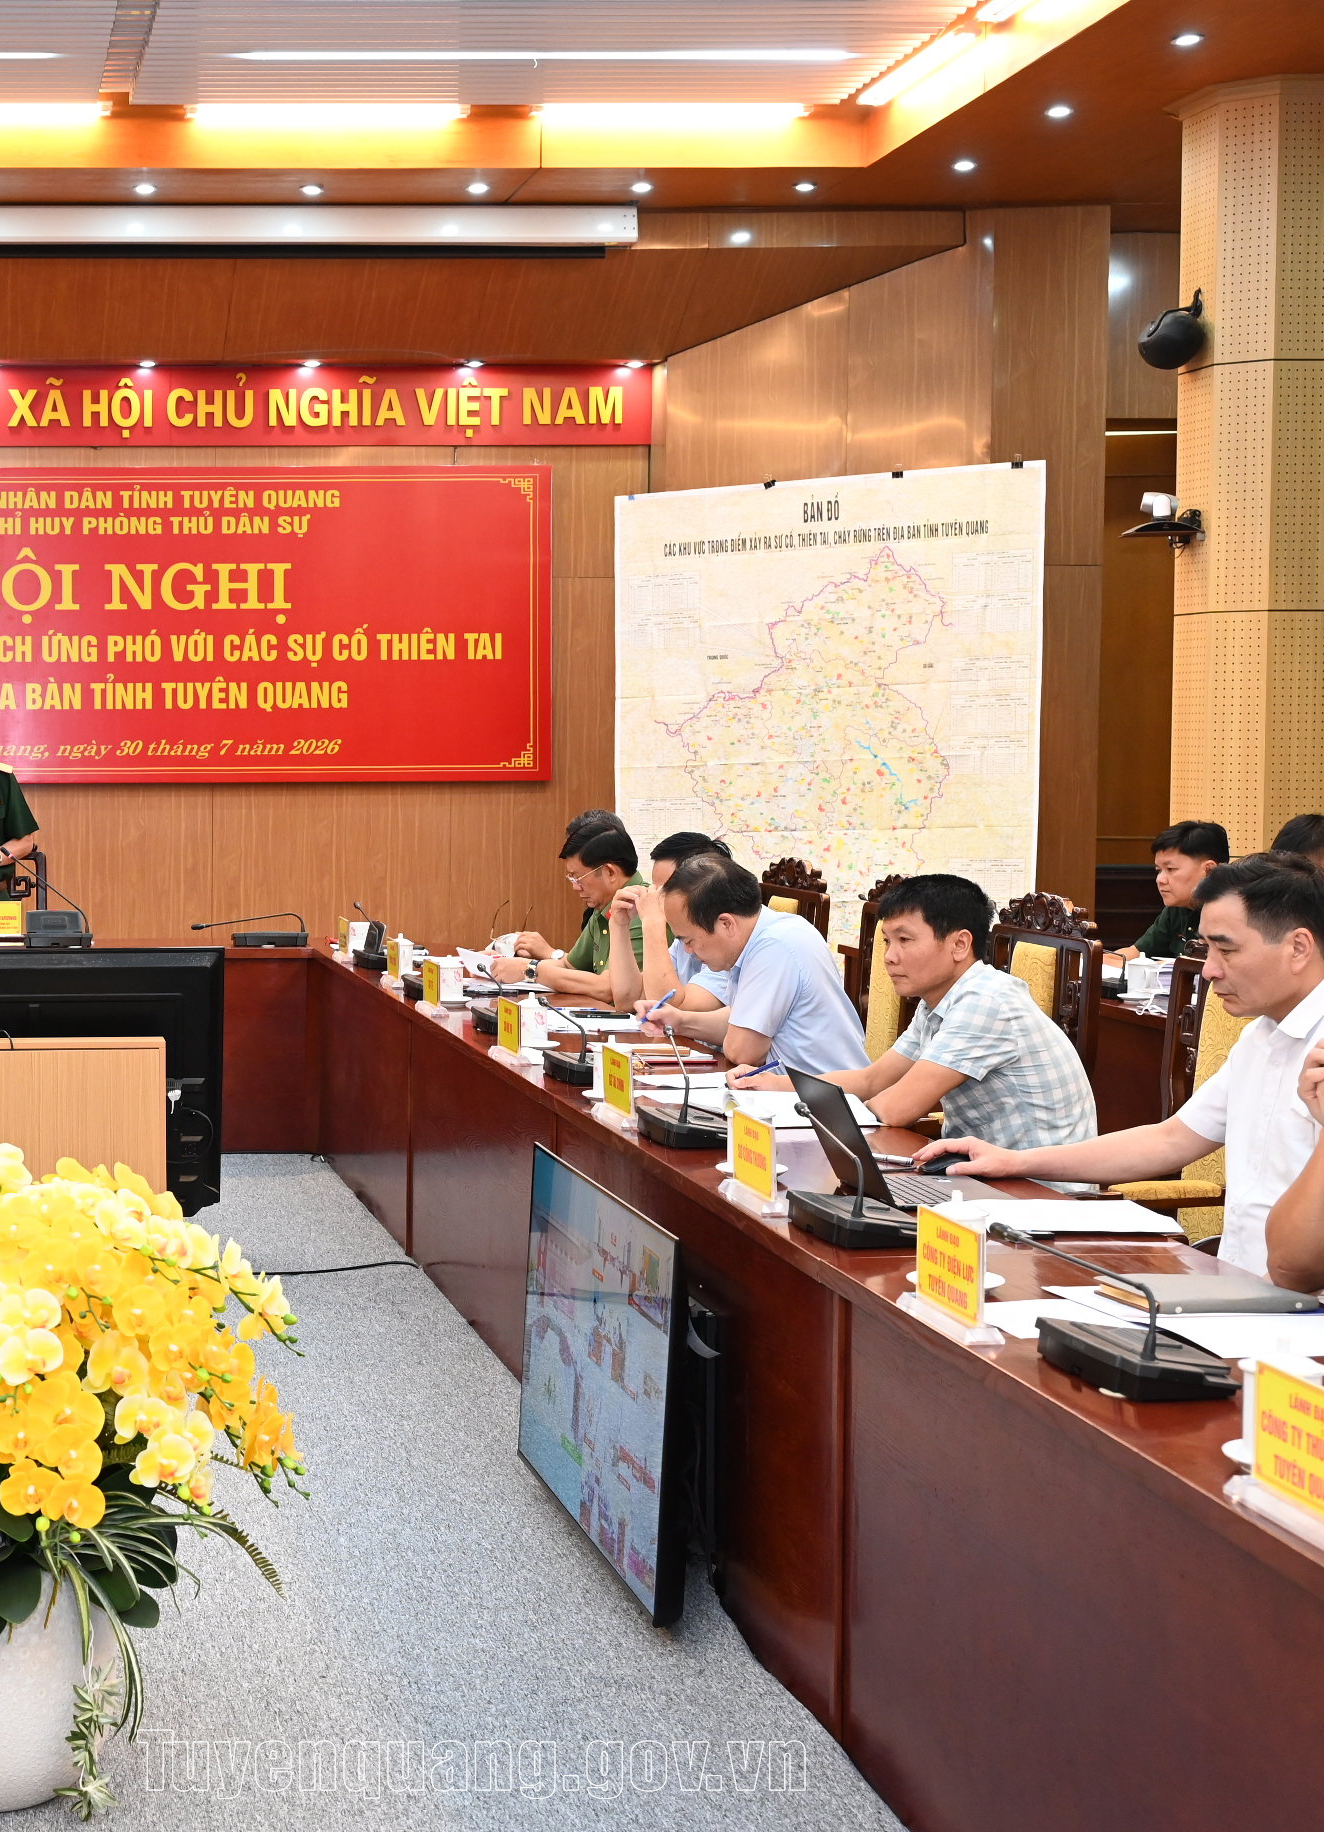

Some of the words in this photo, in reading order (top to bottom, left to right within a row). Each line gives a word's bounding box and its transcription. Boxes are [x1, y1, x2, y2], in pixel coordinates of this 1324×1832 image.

[7, 377, 70, 427] XÃ
[82, 378, 154, 438] HỘI
[166, 372, 254, 428] CHỦ
[268, 375, 406, 427] NGHĨA
[415, 377, 509, 438] VIỆT
[522, 386, 624, 426] NAM
[64, 487, 113, 509] DÂN
[119, 485, 174, 509] TỈNH
[180, 487, 255, 509] TUYÊN
[262, 490, 341, 510] QUANG
[29, 517, 75, 535] HUY
[82, 513, 163, 535] PHÒNG
[169, 510, 214, 535] THỦ
[221, 513, 270, 535] DÂN
[277, 514, 311, 538] SỰ
[664, 540, 677, 557] CÁC
[678, 541, 691, 556] KHU
[693, 539, 706, 558] VỰC
[707, 538, 729, 557] TRỌNG
[763, 535, 772, 550] RA
[774, 533, 784, 552] SỰ
[798, 529, 818, 548] THIÊN
[874, 524, 891, 542] TRÊN
[893, 525, 905, 543] ĐỊA
[941, 519, 963, 537] TUYÊN
[965, 519, 989, 536] QUANG
[104, 562, 292, 624] NGHỊ
[42, 630, 98, 663] ỨNG
[108, 630, 162, 662] PHÓ
[170, 629, 214, 662] VỚI
[223, 629, 278, 662] CÁC
[286, 631, 327, 668] SỰ
[332, 624, 369, 661] CỐ
[376, 627, 455, 660] THIÊN
[463, 633, 503, 660] TAI
[26, 677, 82, 710] BÀN
[91, 673, 153, 710] TỈNH
[162, 676, 248, 709] TUYÊN
[257, 681, 348, 712] QUANG
[56, 741, 112, 760] ngày
[116, 740, 143, 756] 30
[147, 739, 214, 759] tháng
[219, 740, 235, 756] 7
[235, 739, 285, 756] năm
[289, 738, 342, 756] 2026
[936, 1226, 949, 1243] LÃNH
[949, 1233, 960, 1249] ĐẠO
[923, 1241, 938, 1266] CÔNG
[939, 1250, 946, 1270] TY
[947, 1254, 961, 1279] ĐIỆN
[963, 1262, 974, 1286] LỰC
[928, 1273, 946, 1298] TUYÊN
[947, 1284, 968, 1310] QUANG
[1290, 1392, 1312, 1417] LÃNH
[1261, 1409, 1288, 1443] CÔNG
[1292, 1425, 1303, 1450] TY
[1274, 1454, 1306, 1490] TUYÊN
